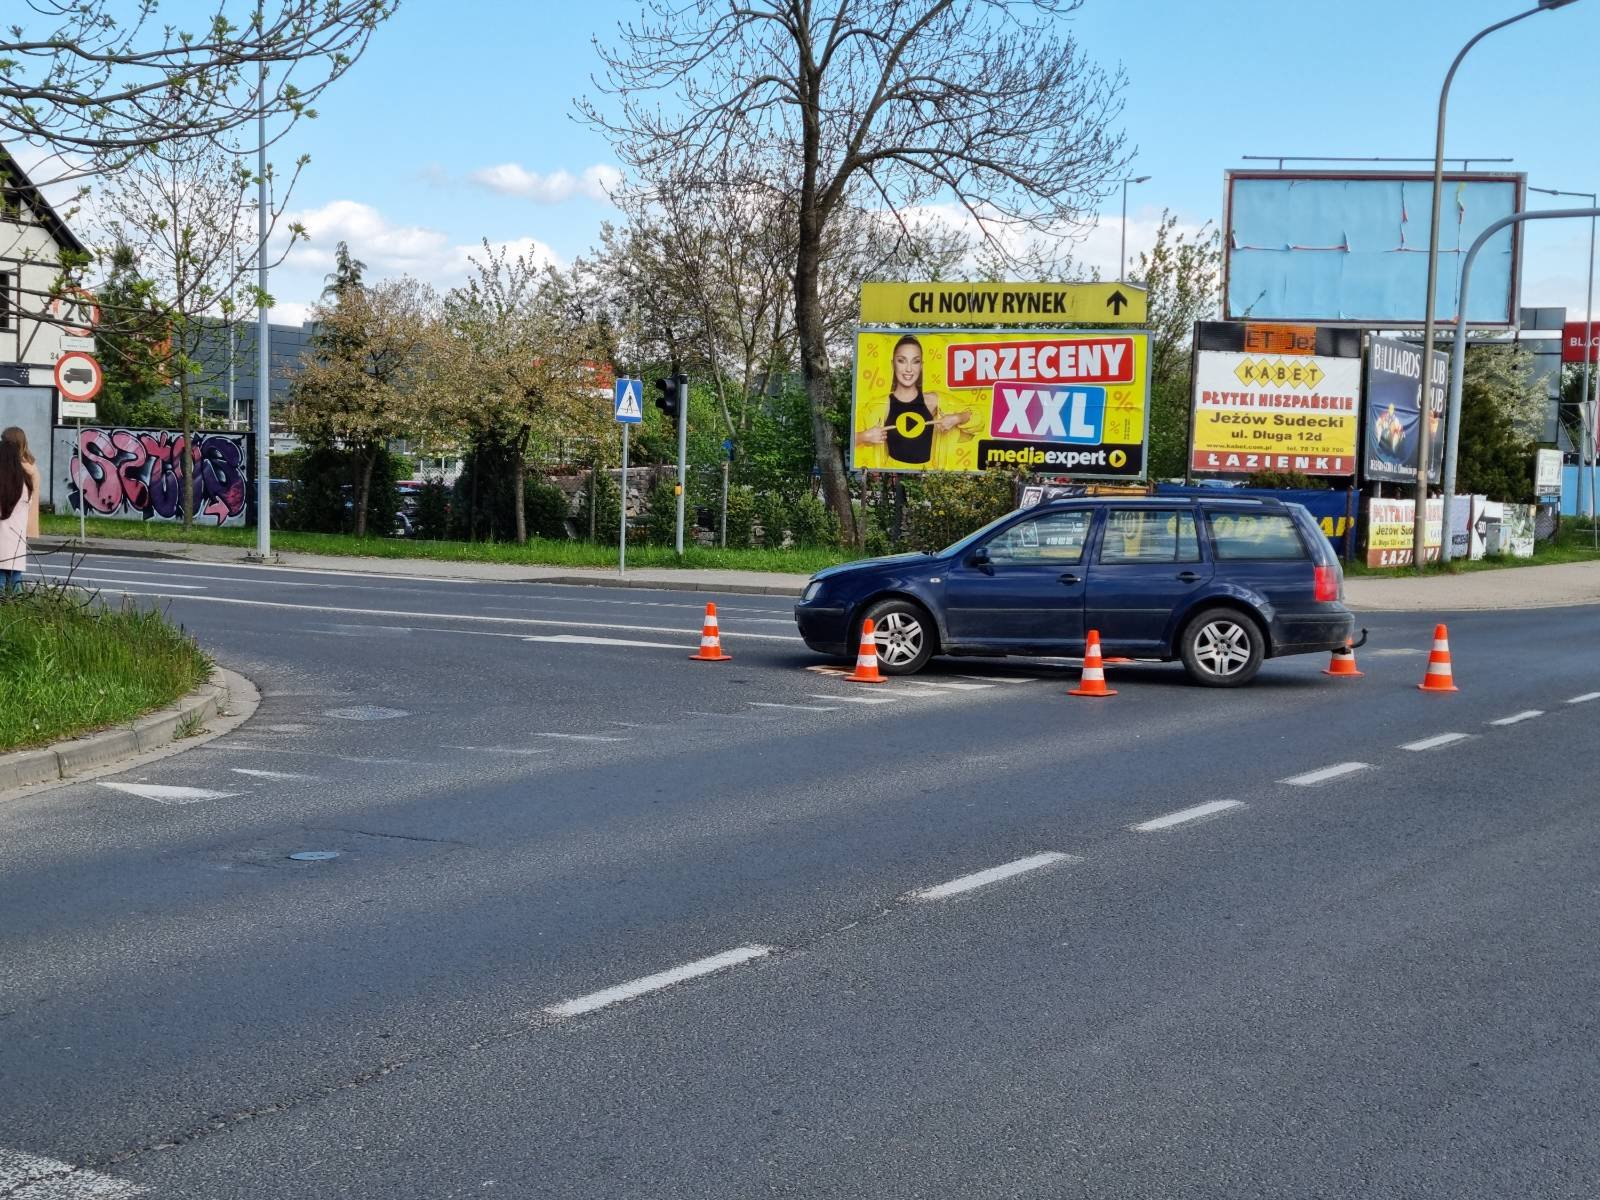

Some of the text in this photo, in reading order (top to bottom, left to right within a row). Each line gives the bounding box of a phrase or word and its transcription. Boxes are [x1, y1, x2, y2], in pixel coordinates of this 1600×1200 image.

[908, 291, 1067, 314] CH NOWY RYNEK
[954, 343, 1126, 381] PRZECENY
[1244, 365, 1318, 382] KABET
[1202, 390, 1353, 410] PŁYTKI HISZPAŃSKIE
[998, 388, 1096, 438] XXL
[1210, 412, 1344, 428] Jeżów Sudecki
[1231, 430, 1322, 442] ul. Długa 12d
[987, 447, 1106, 466] mediaexpert
[1207, 453, 1341, 470] ŁAZIENKI
[1381, 547, 1440, 565] ŁAZIKI
